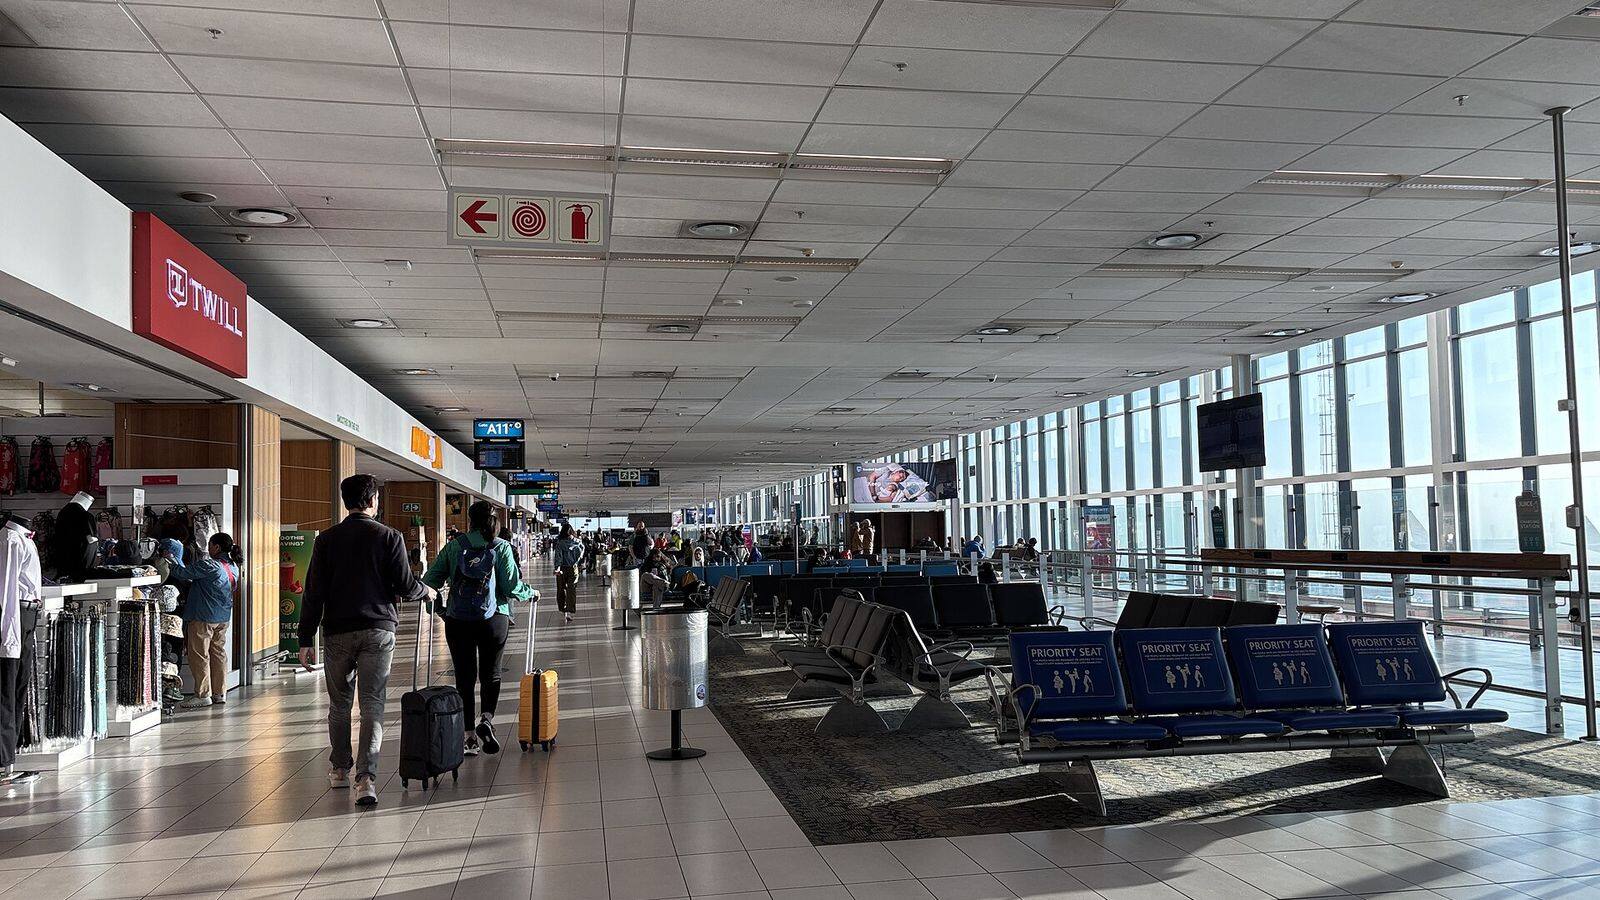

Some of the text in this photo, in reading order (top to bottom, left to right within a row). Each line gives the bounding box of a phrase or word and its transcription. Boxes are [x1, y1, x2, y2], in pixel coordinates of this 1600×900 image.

[189, 278, 243, 337] TWILL
[487, 423, 509, 435] A11
[281, 622, 292, 630] THE
[1142, 642, 1211, 654] PRIORITY SEAT
[1248, 639, 1314, 651] PRIORITY SEAT
[1351, 637, 1417, 648] PRIORITY SEAT
[1031, 647, 1103, 658] PRIORITY SEAT
